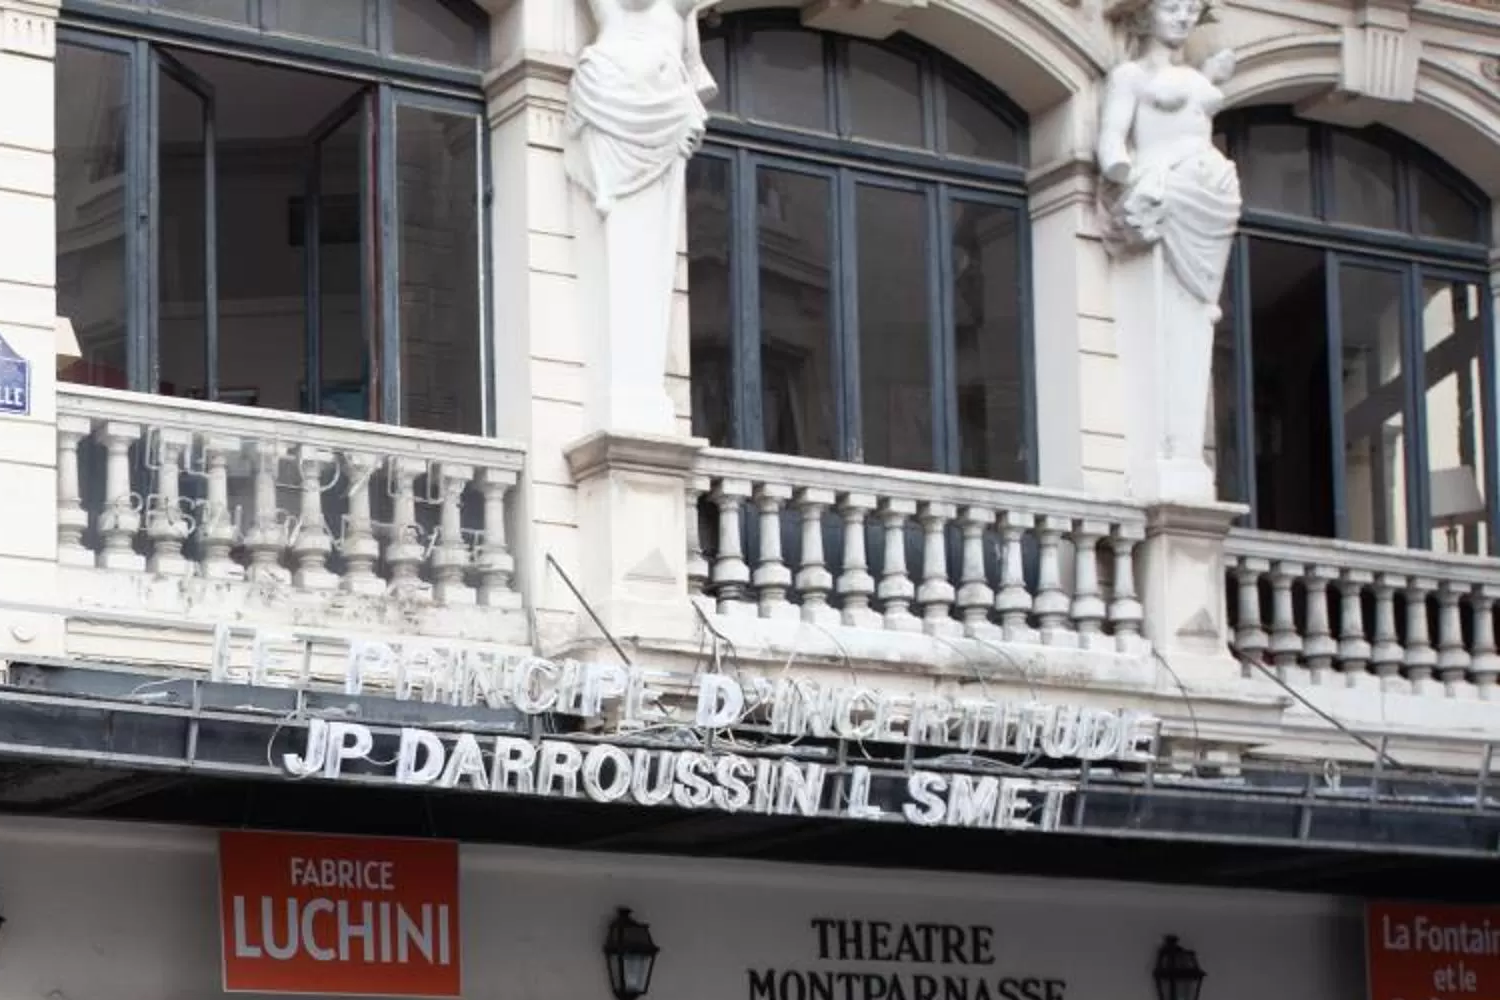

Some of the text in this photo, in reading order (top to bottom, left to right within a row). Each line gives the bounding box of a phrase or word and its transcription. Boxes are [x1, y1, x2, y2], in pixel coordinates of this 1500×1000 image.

[211, 622, 295, 687] LE
[344, 637, 671, 722] PRINCIPE
[284, 718, 373, 780] JP
[396, 727, 827, 817] DARROUSSIN
[902, 770, 1078, 832] SMET
[290, 857, 395, 891] FABRICE
[232, 895, 451, 966] LUCHINI
[810, 917, 995, 966] THEATRE
[1383, 914, 1410, 949] La
[1433, 960, 1477, 992] et le
